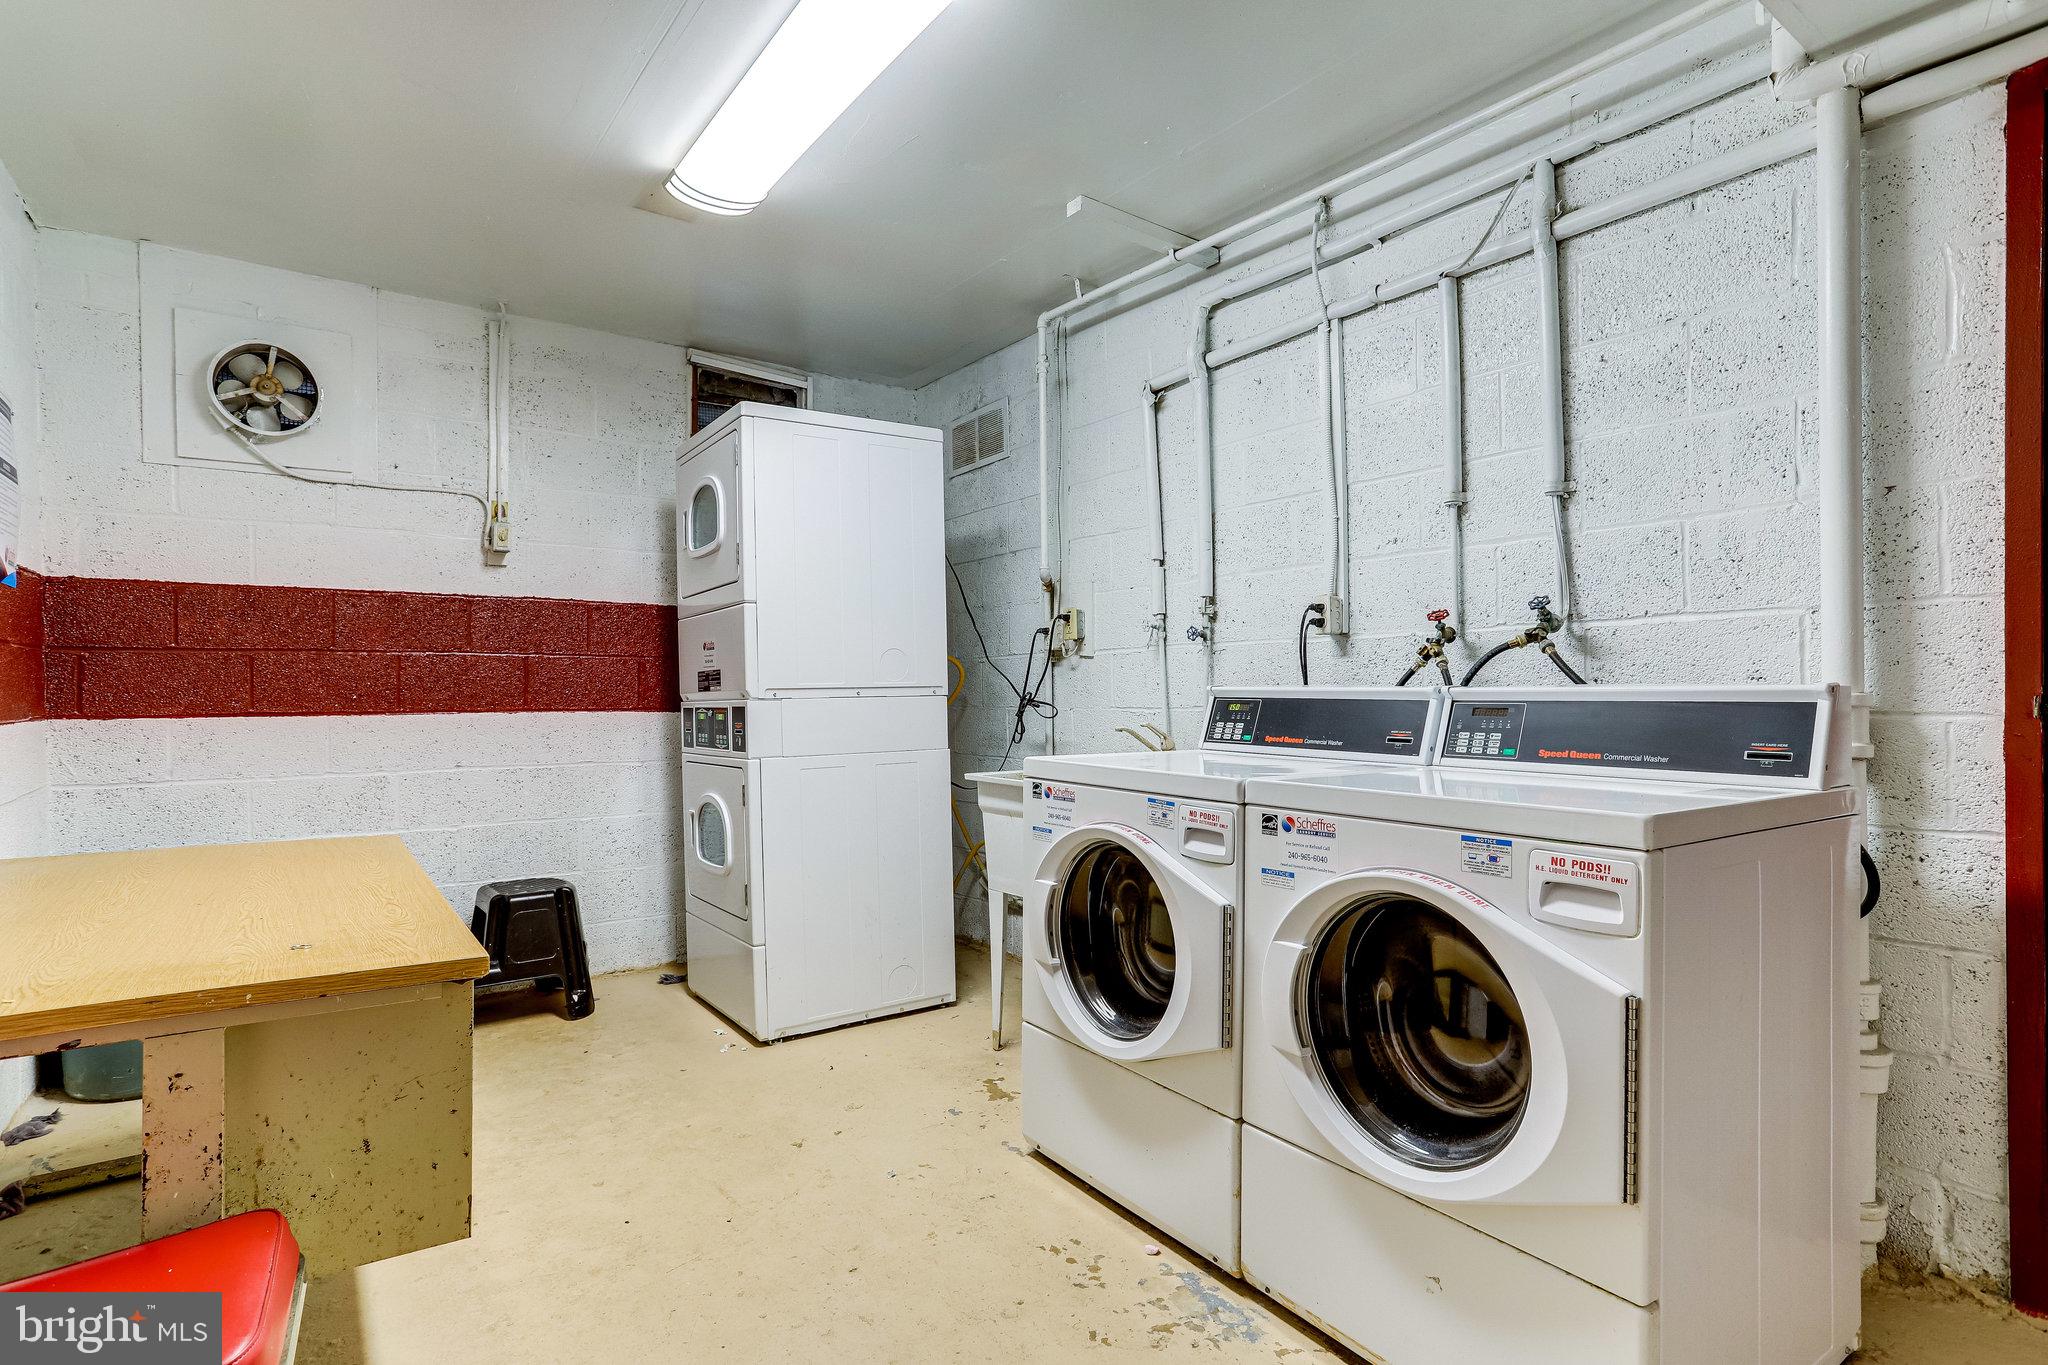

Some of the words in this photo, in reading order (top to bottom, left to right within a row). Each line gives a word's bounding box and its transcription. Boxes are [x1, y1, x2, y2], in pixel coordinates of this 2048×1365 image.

[1264, 735, 1284, 743] Speed
[1284, 736, 1304, 744] Queen
[1304, 737, 1327, 745] Commercial
[1327, 738, 1343, 746] Washer
[1538, 749, 1569, 758] Speed
[1569, 750, 1602, 760] Queen
[1603, 752, 1642, 762] Commercial
[1643, 755, 1670, 763] Washer
[1189, 810, 1198, 818] NO
[1296, 816, 1337, 833] Scheffres
[1287, 851, 1328, 864] 240-965-6040
[1551, 856, 1566, 867] NO
[1571, 859, 1611, 875] PODS!!
[1419, 873, 1455, 890] WHEN
[1548, 866, 1568, 876] LIQUID
[1571, 870, 1608, 882] DETERGENT
[1611, 876, 1629, 885] ONLY
